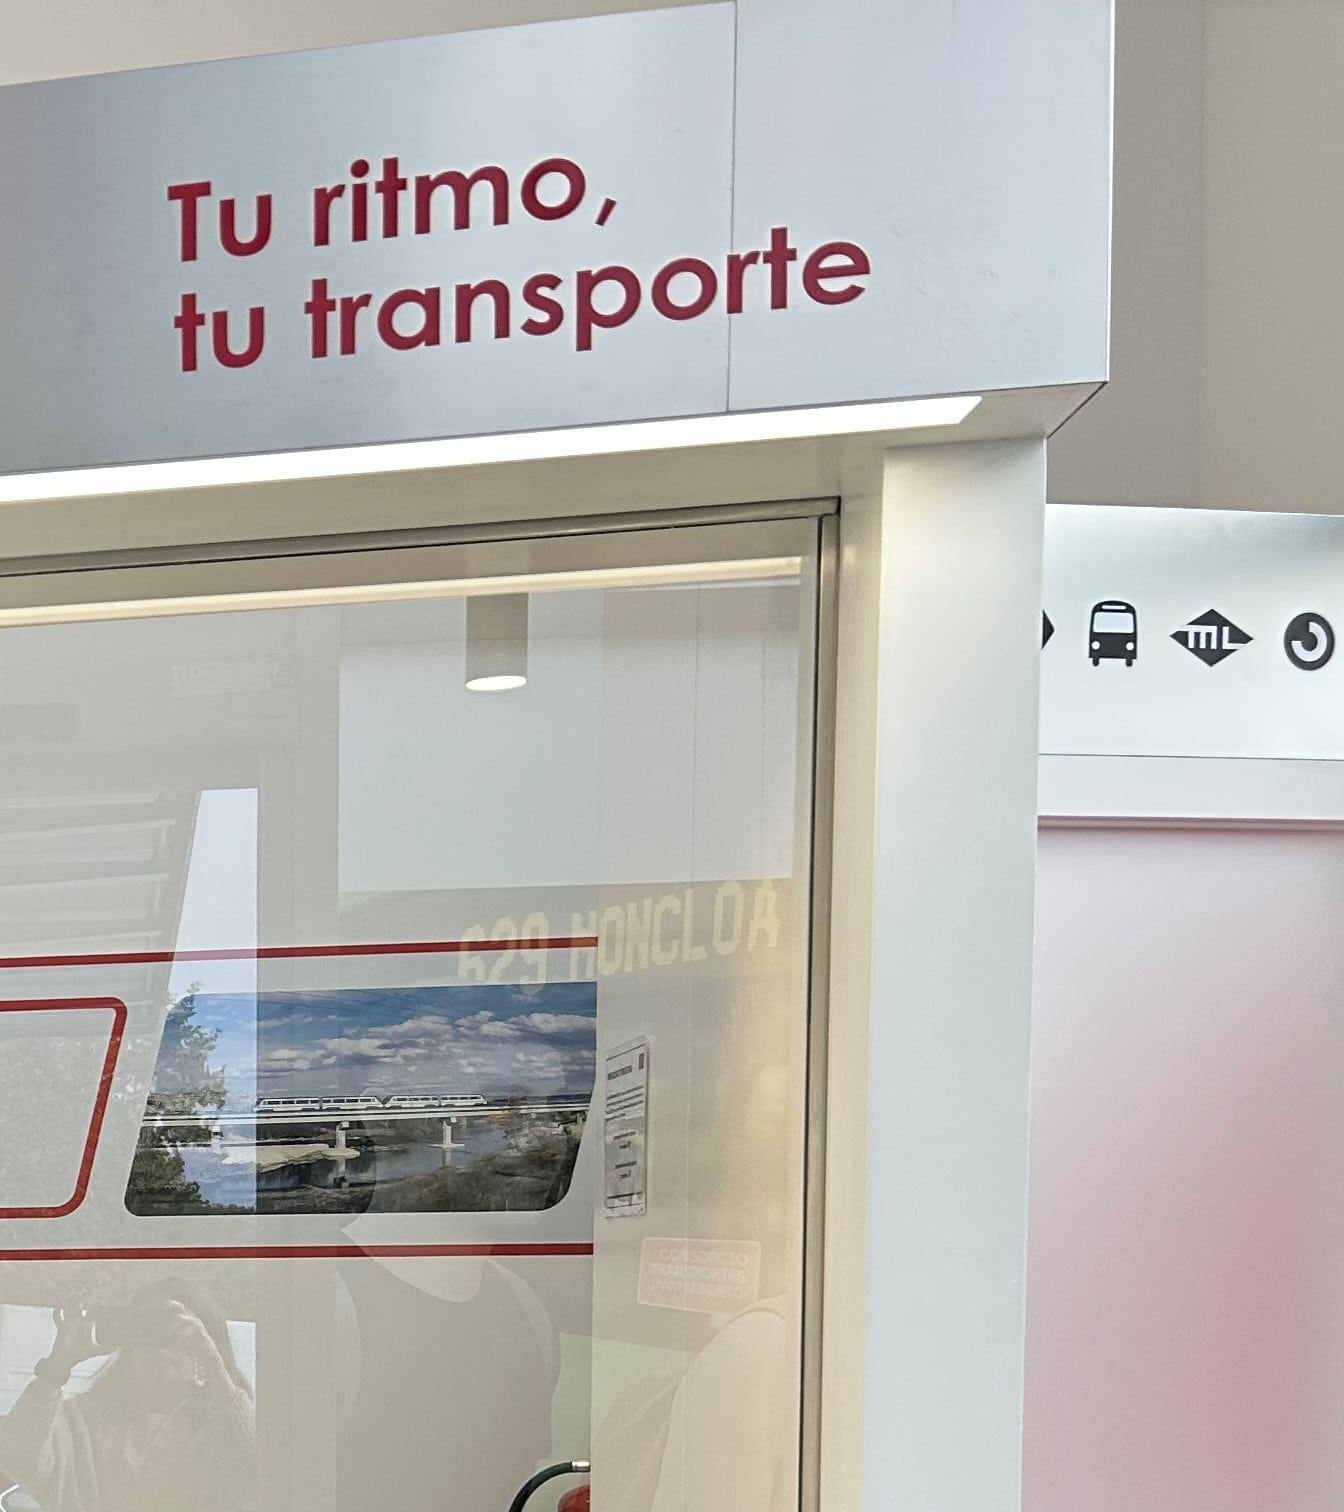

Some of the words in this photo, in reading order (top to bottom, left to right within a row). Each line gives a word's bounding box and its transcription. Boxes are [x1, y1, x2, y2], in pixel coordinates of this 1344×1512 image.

[168, 181, 272, 262] Tu
[313, 157, 617, 247] ritmo,
[174, 293, 264, 372] tu
[304, 226, 871, 359] transporte
